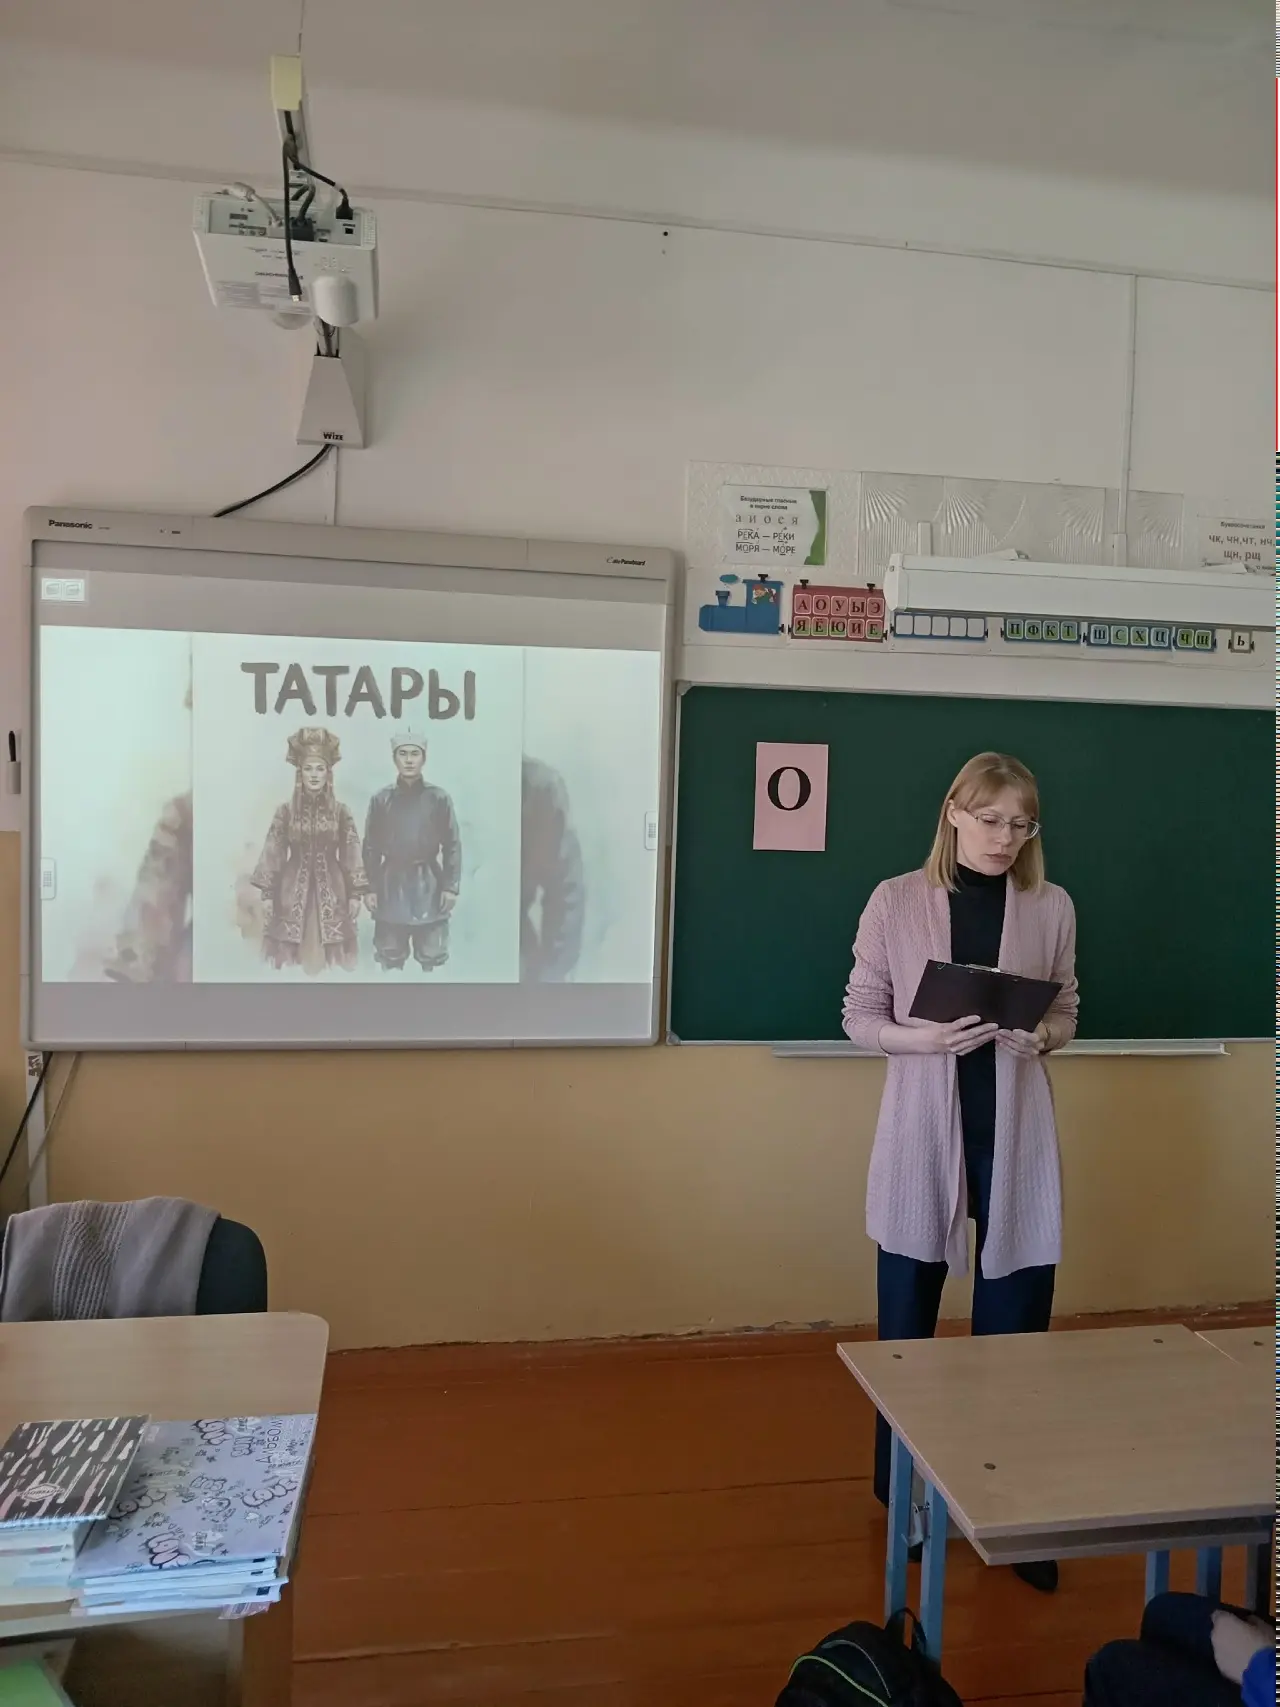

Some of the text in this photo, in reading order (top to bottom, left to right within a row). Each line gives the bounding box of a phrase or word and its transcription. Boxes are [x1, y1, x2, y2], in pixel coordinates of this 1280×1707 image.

[49, 519, 93, 530] Panasonic
[240, 662, 477, 721] ТАТАРЫ
[767, 766, 812, 811] О
